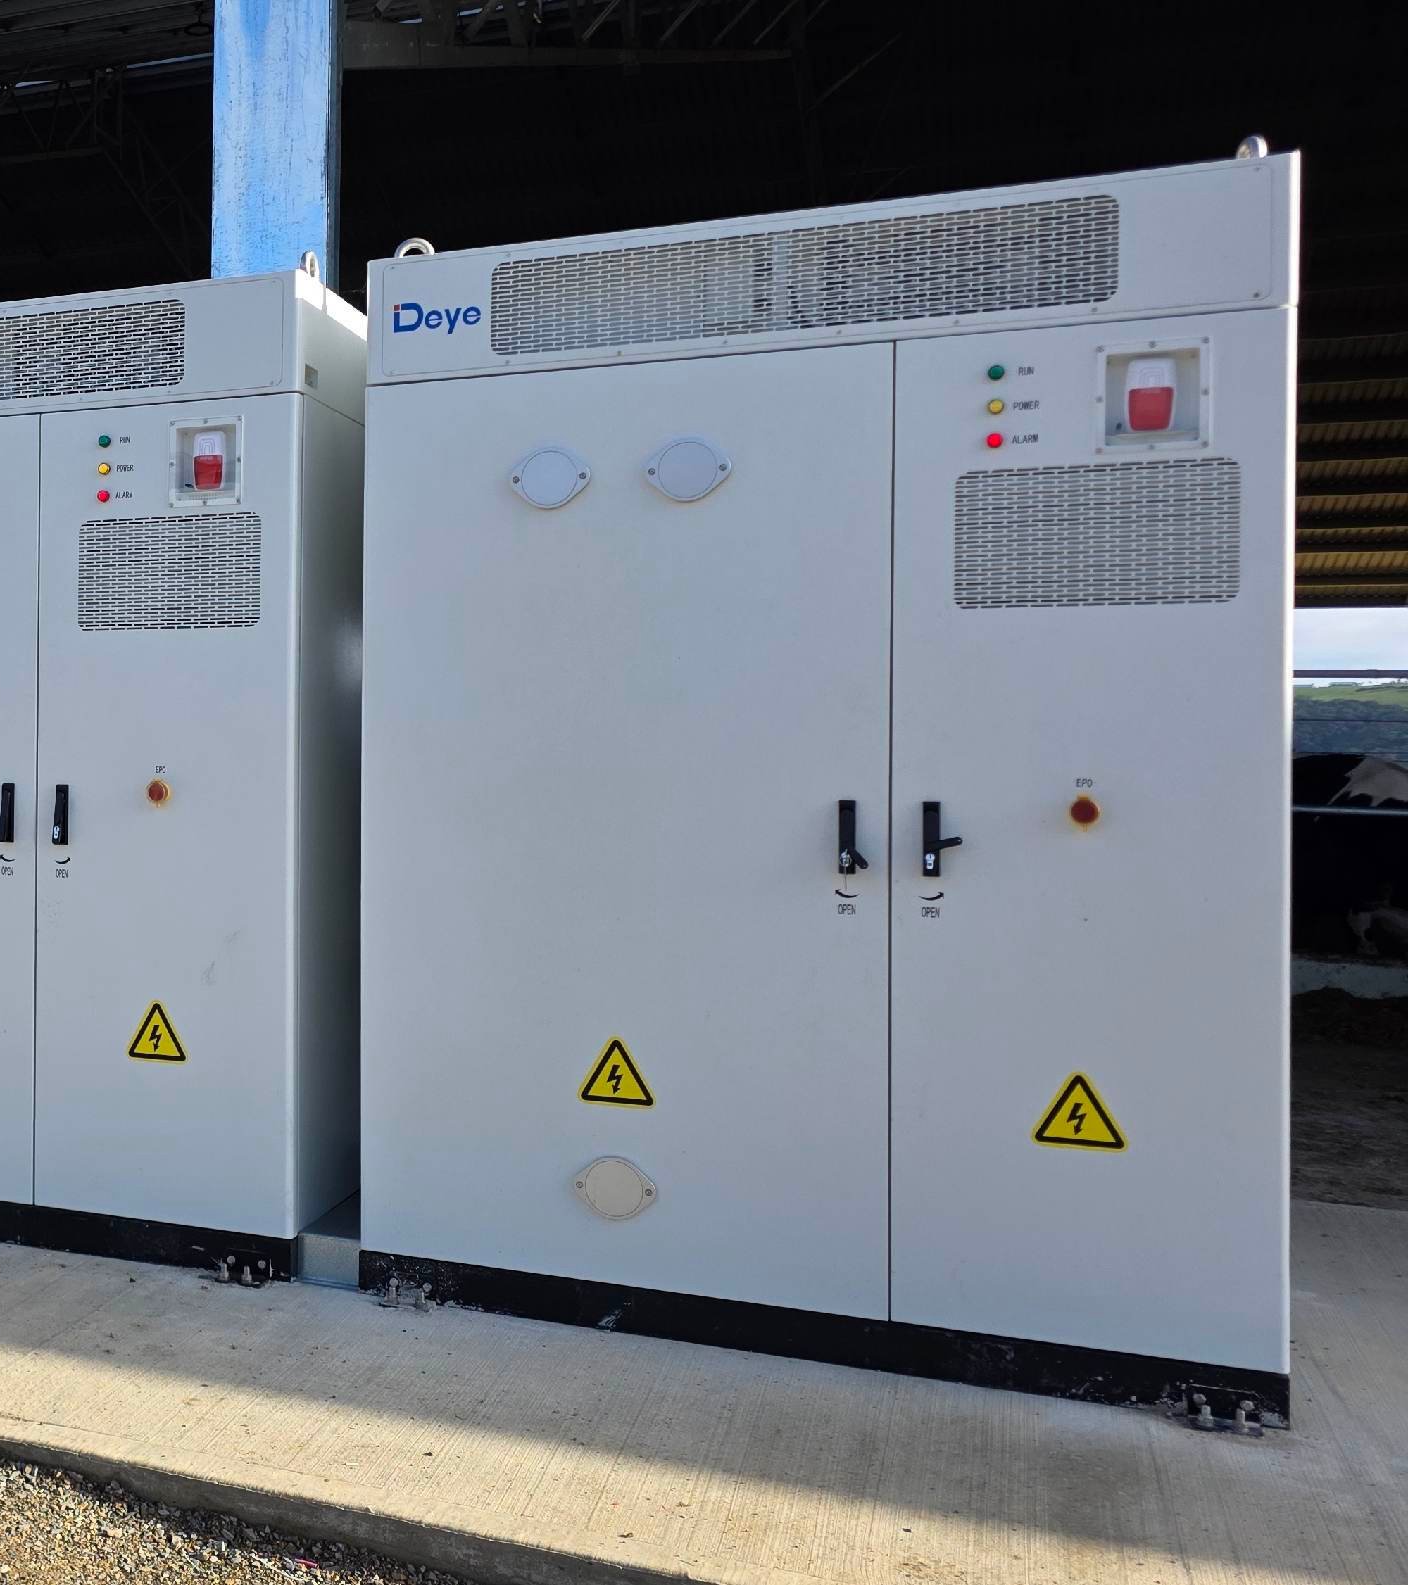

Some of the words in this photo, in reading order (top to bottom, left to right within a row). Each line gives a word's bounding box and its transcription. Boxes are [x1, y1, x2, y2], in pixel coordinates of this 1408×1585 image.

[393, 302, 481, 335] Deye
[1018, 366, 1035, 376] RUN
[1012, 400, 1040, 411] POWER
[1012, 433, 1039, 445] ALARM
[837, 903, 856, 916] OPEN
[921, 906, 941, 918] OPEN
